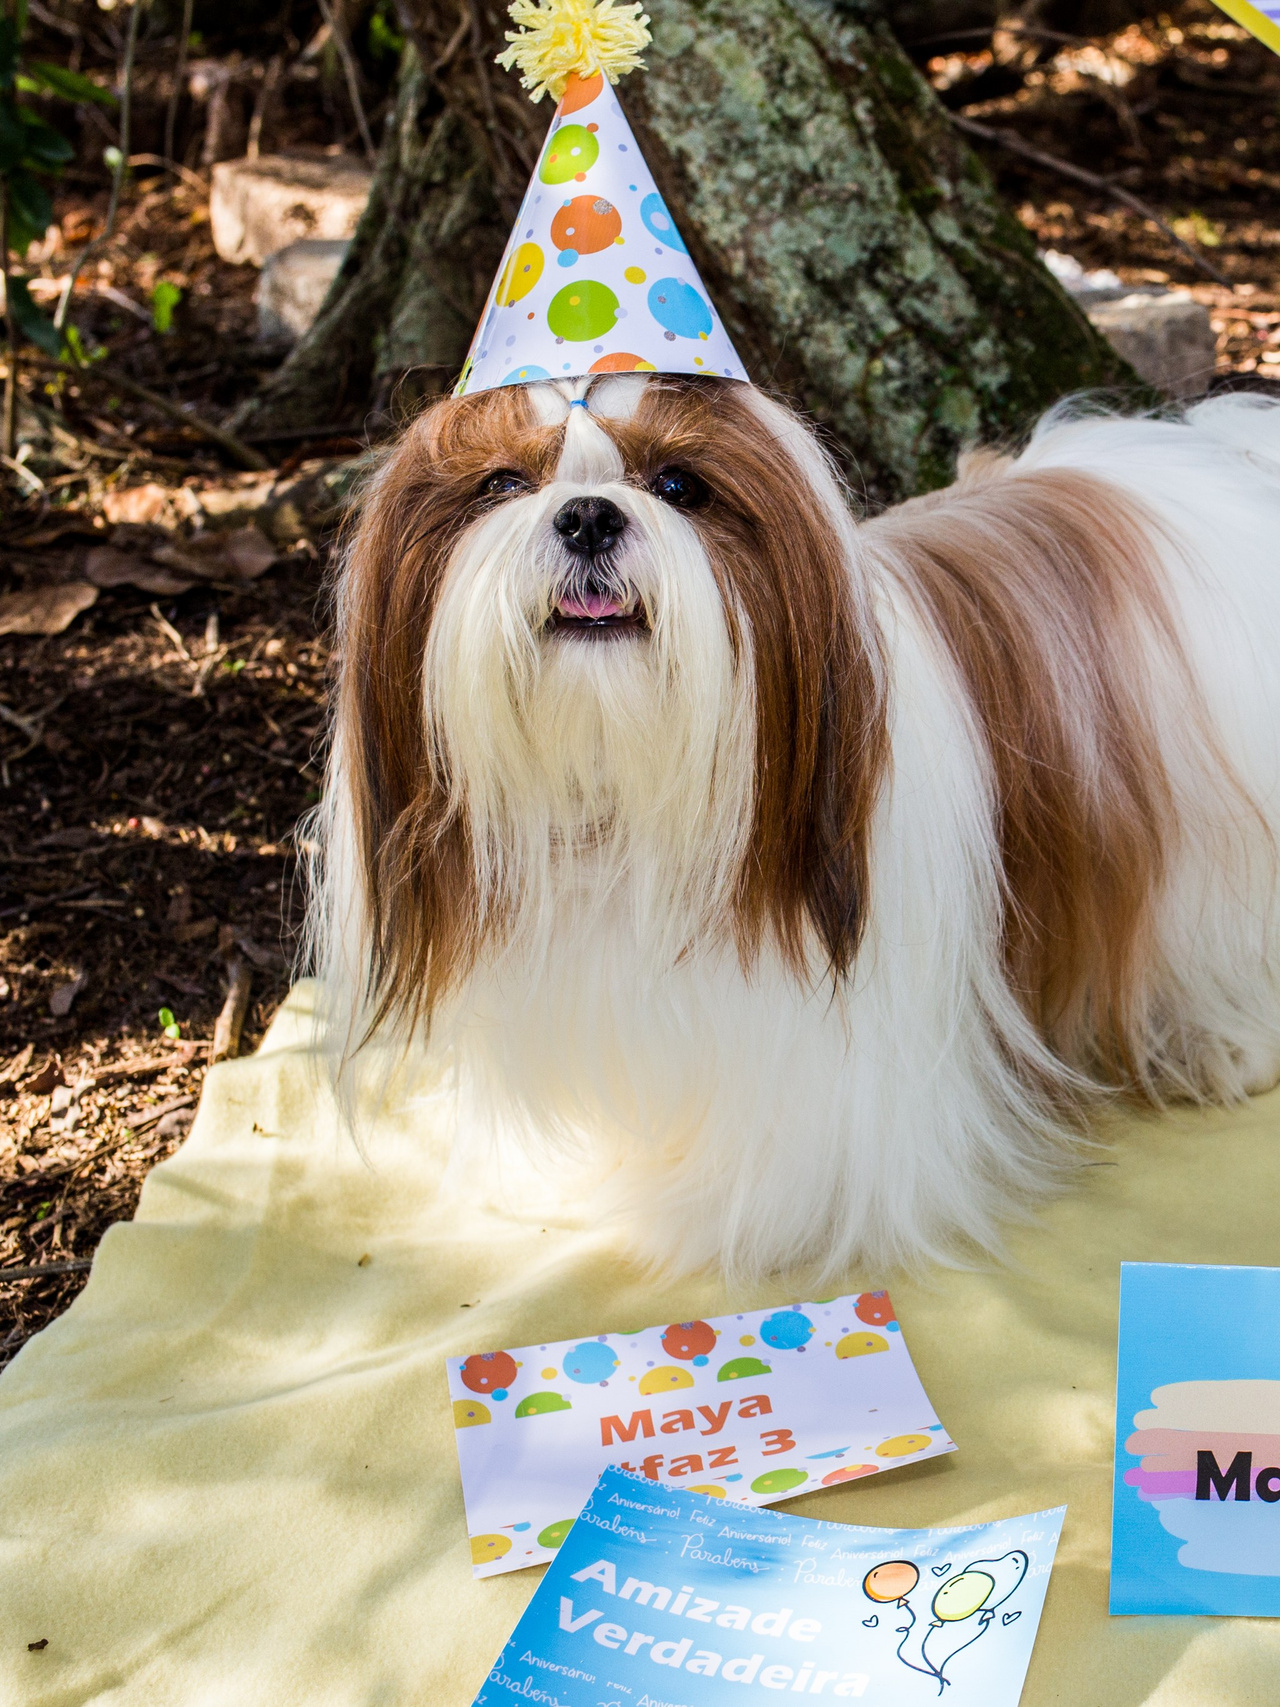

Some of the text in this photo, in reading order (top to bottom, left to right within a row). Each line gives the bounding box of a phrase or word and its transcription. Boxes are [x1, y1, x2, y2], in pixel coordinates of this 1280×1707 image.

[599, 1394, 774, 1447] Maya
[598, 1445, 739, 1481] faz
[759, 1428, 797, 1457] 3
[606, 1492, 680, 1519] Aniversário!
[689, 1509, 717, 1527] Feliz
[717, 1526, 792, 1547] Aniversário!
[800, 1534, 828, 1551] Feliz
[569, 1558, 822, 1643] Amizade
[558, 1595, 870, 1698] Verdadeira
